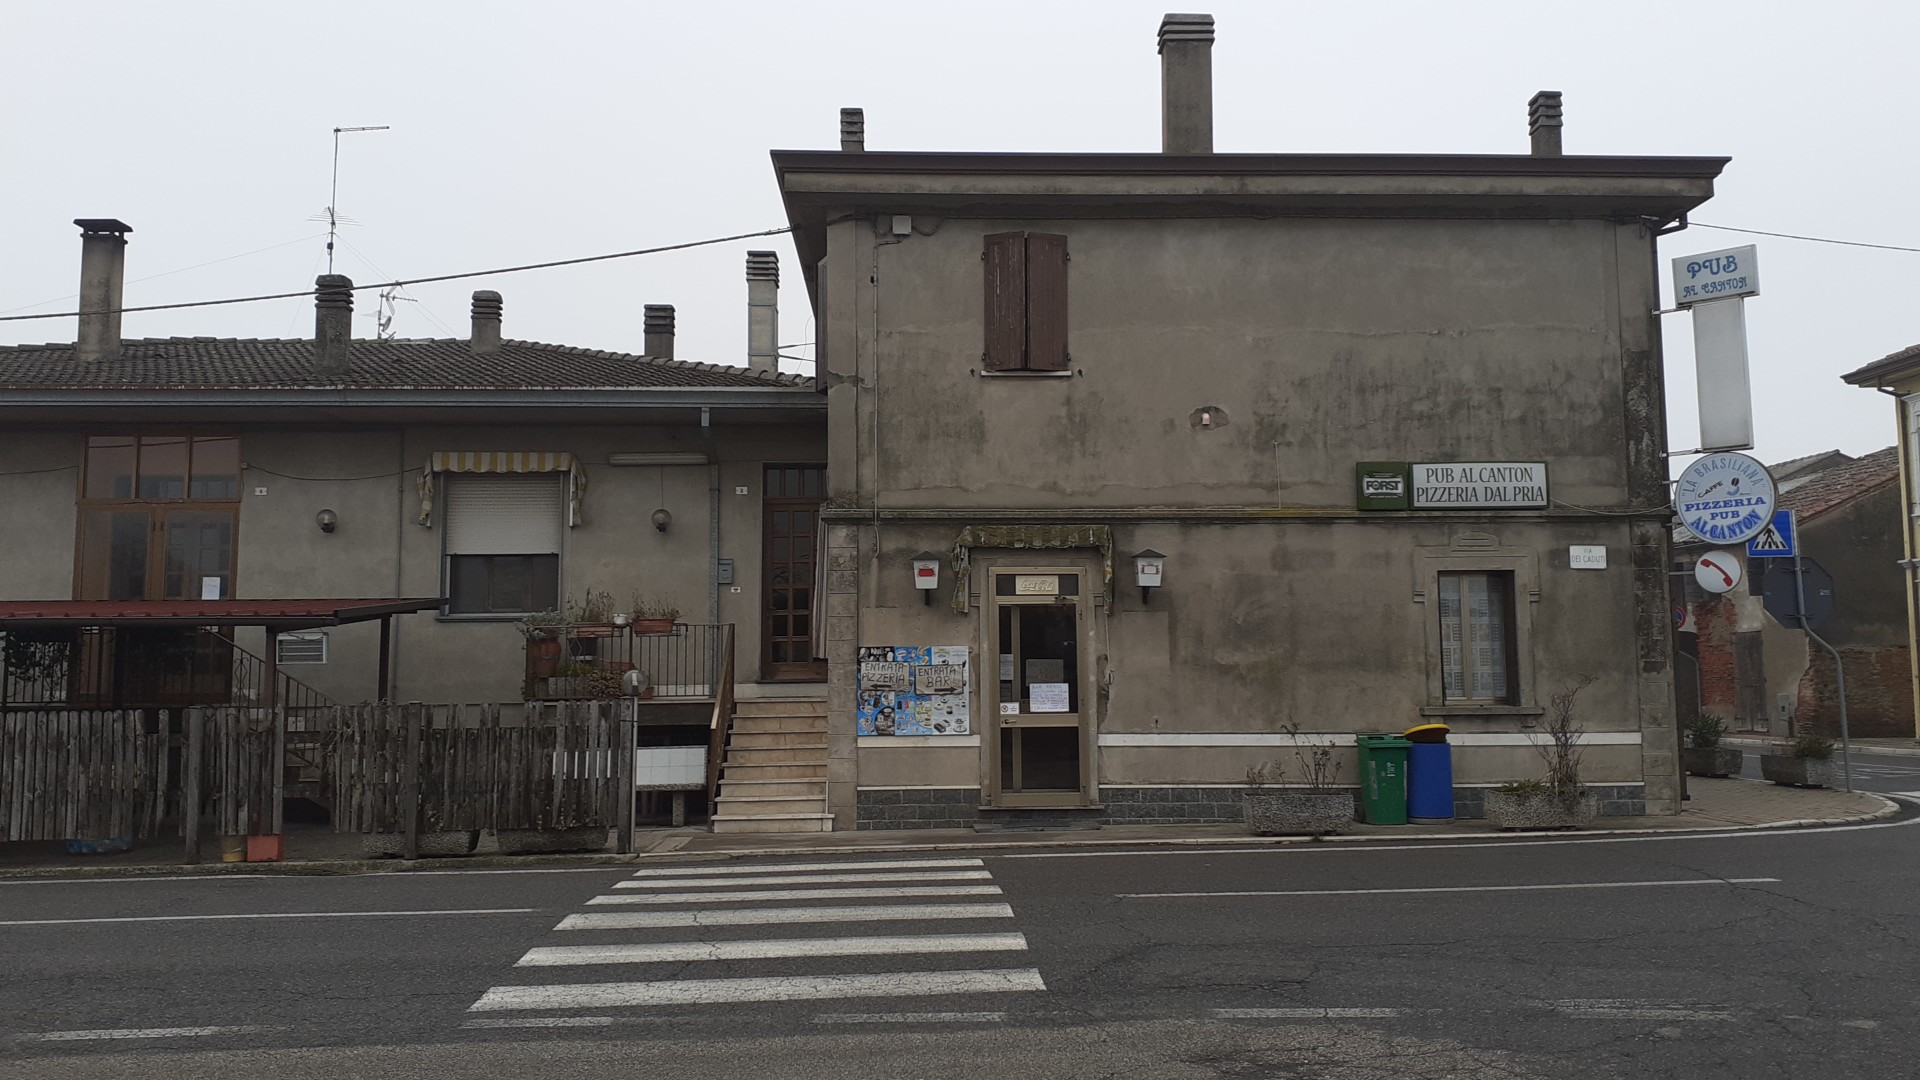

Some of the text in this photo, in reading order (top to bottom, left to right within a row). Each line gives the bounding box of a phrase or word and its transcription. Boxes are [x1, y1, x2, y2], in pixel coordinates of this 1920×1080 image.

[1686, 255, 1738, 279] PUB
[1683, 276, 1748, 298] AL CANTON
[1426, 466, 1533, 483] PUB AL CANTON
[1366, 480, 1401, 491] FORST
[1416, 485, 1545, 503] PIZZERIA DAL PRIA
[1684, 496, 1767, 512] PIZZERIA
[1710, 510, 1740, 521] PUB
[1690, 508, 1763, 540] AL CANTON
[865, 662, 904, 672] ENTRATA
[918, 665, 956, 676] ENTRATA
[926, 676, 950, 688] BAR
